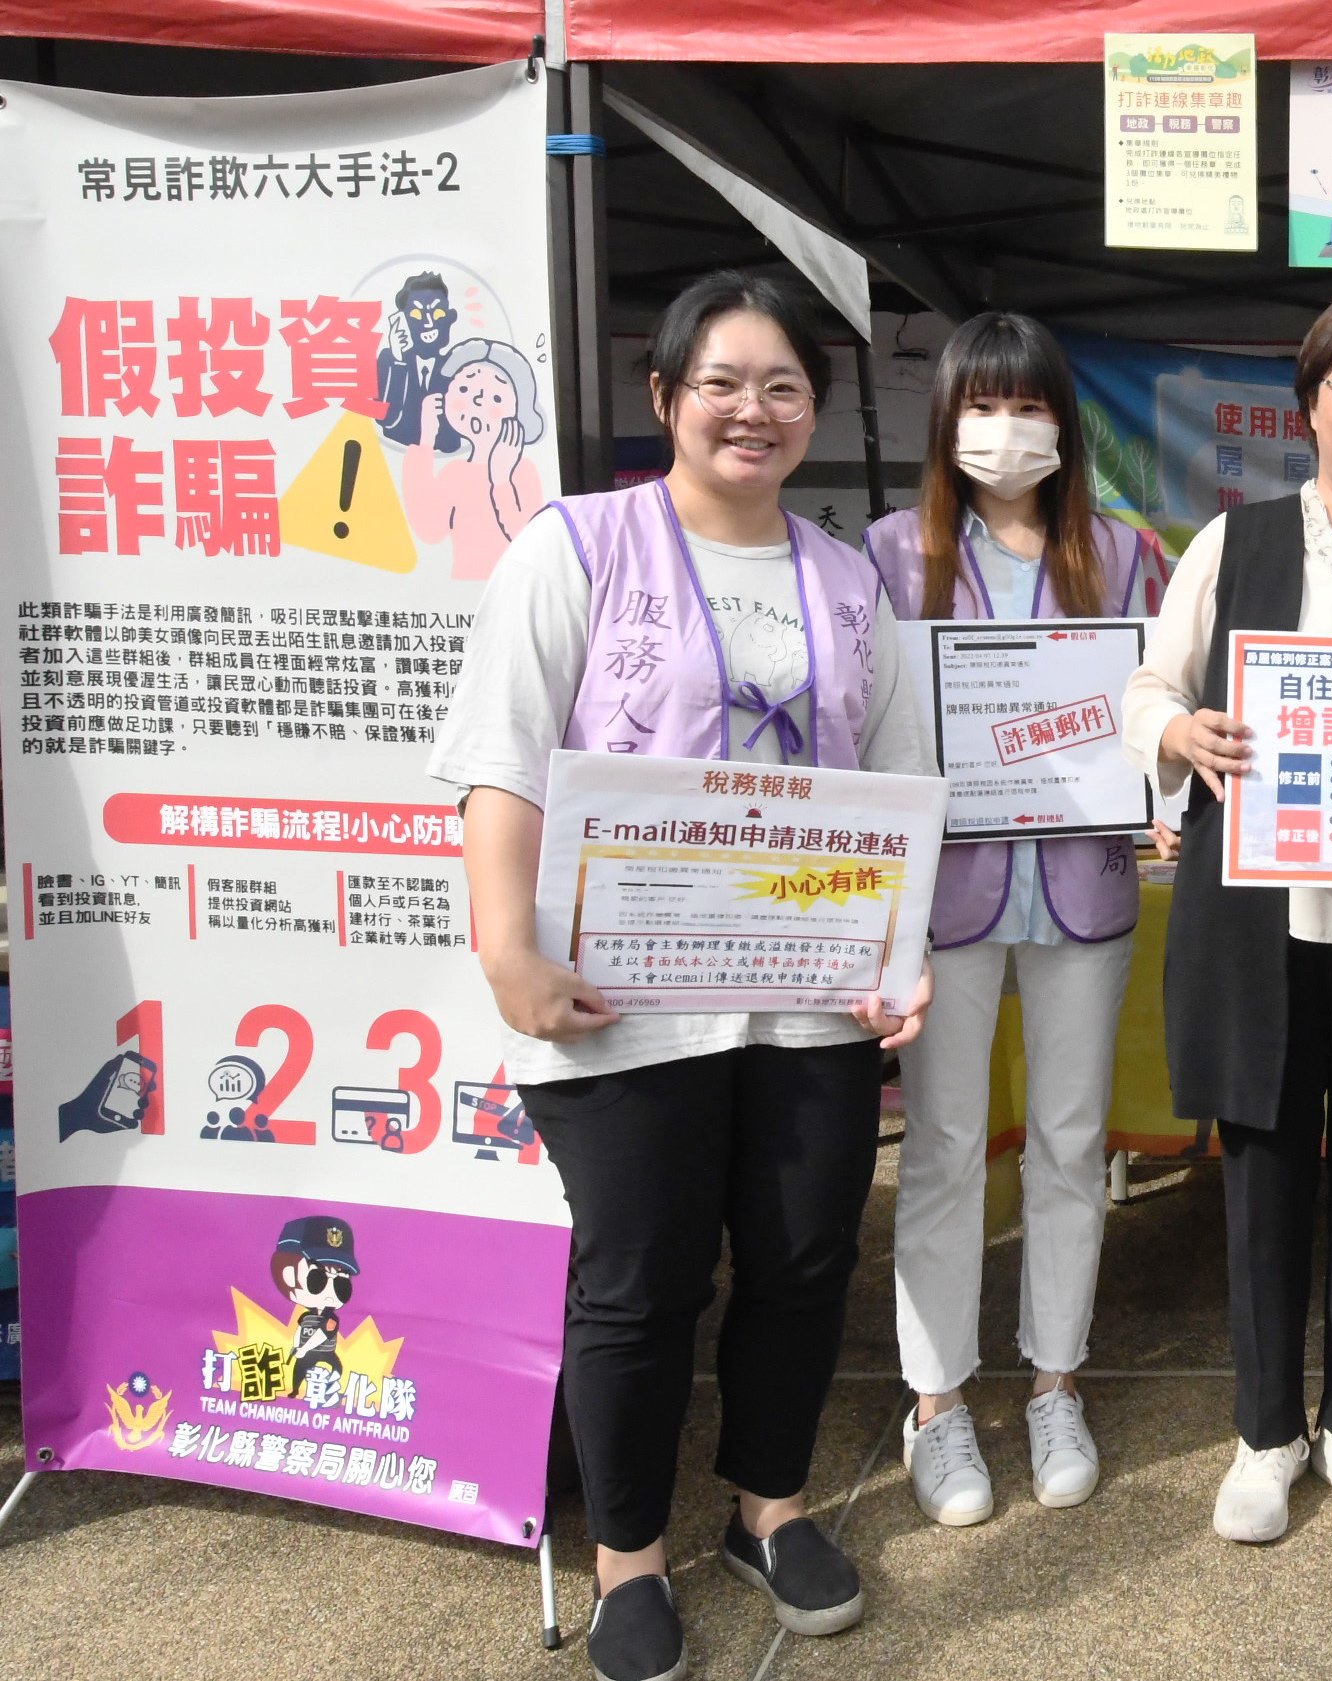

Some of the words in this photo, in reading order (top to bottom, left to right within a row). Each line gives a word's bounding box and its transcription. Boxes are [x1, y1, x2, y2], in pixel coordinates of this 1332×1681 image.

[1117, 91, 1243, 109] 打詐連線集章趣
[1126, 118, 1149, 130] 地政
[1211, 119, 1234, 131] 警察
[78, 151, 460, 202] 常見詐欺六大手法-2
[49, 295, 390, 420] 假投資
[55, 436, 282, 556] 詐騙
[18, 602, 474, 629] 此類詐騙手法是利用廣發簡訊，吸引民眾點擊連結加入LIN
[18, 624, 467, 653] 社群軟體以帥美女頭像向民眾丟出陌生訊息邀請加入投資
[21, 670, 457, 699] 並刻意展現優渥生活，讓民眾心動而聽話投資。高獲利
[946, 701, 1058, 716] 牌照稅扣繳異常通知
[1001, 704, 1105, 755] 詐騙郵件
[22, 737, 188, 757] 的就是詐騙關鍵字。
[703, 769, 813, 800] 稅務報報
[1278, 771, 1321, 787] 修正前
[583, 818, 910, 858] E-mail通知申請退稅連結
[207, 878, 277, 895] 假客服群組
[347, 875, 449, 893] 匯款至不認識的
[769, 866, 884, 900] 小心有詐
[207, 896, 292, 914] 提供投資網站
[348, 893, 450, 911] 個人戶或戶名為
[38, 910, 151, 926] 並且加LINE好友
[208, 915, 336, 934] 稱以量化分析高獲利
[349, 912, 450, 930] 建材行、茶葉行
[350, 930, 466, 948] 企業社等人頭帳戶
[628, 970, 834, 986] 不會以email傳送退稅申請連結
[116, 1000, 164, 1136] 1
[235, 1004, 316, 1146] 2
[365, 1009, 442, 1155] 3
[203, 1342, 286, 1402] 打詐
[304, 1367, 416, 1422] 彰化隊
[200, 1397, 236, 1416] TEAM
[239, 1403, 309, 1429] CHANGHUA
[312, 1414, 329, 1431] OF
[333, 1417, 410, 1443] ANTI-FRAUD
[168, 1422, 438, 1495] 彰化縣警察局關心您
